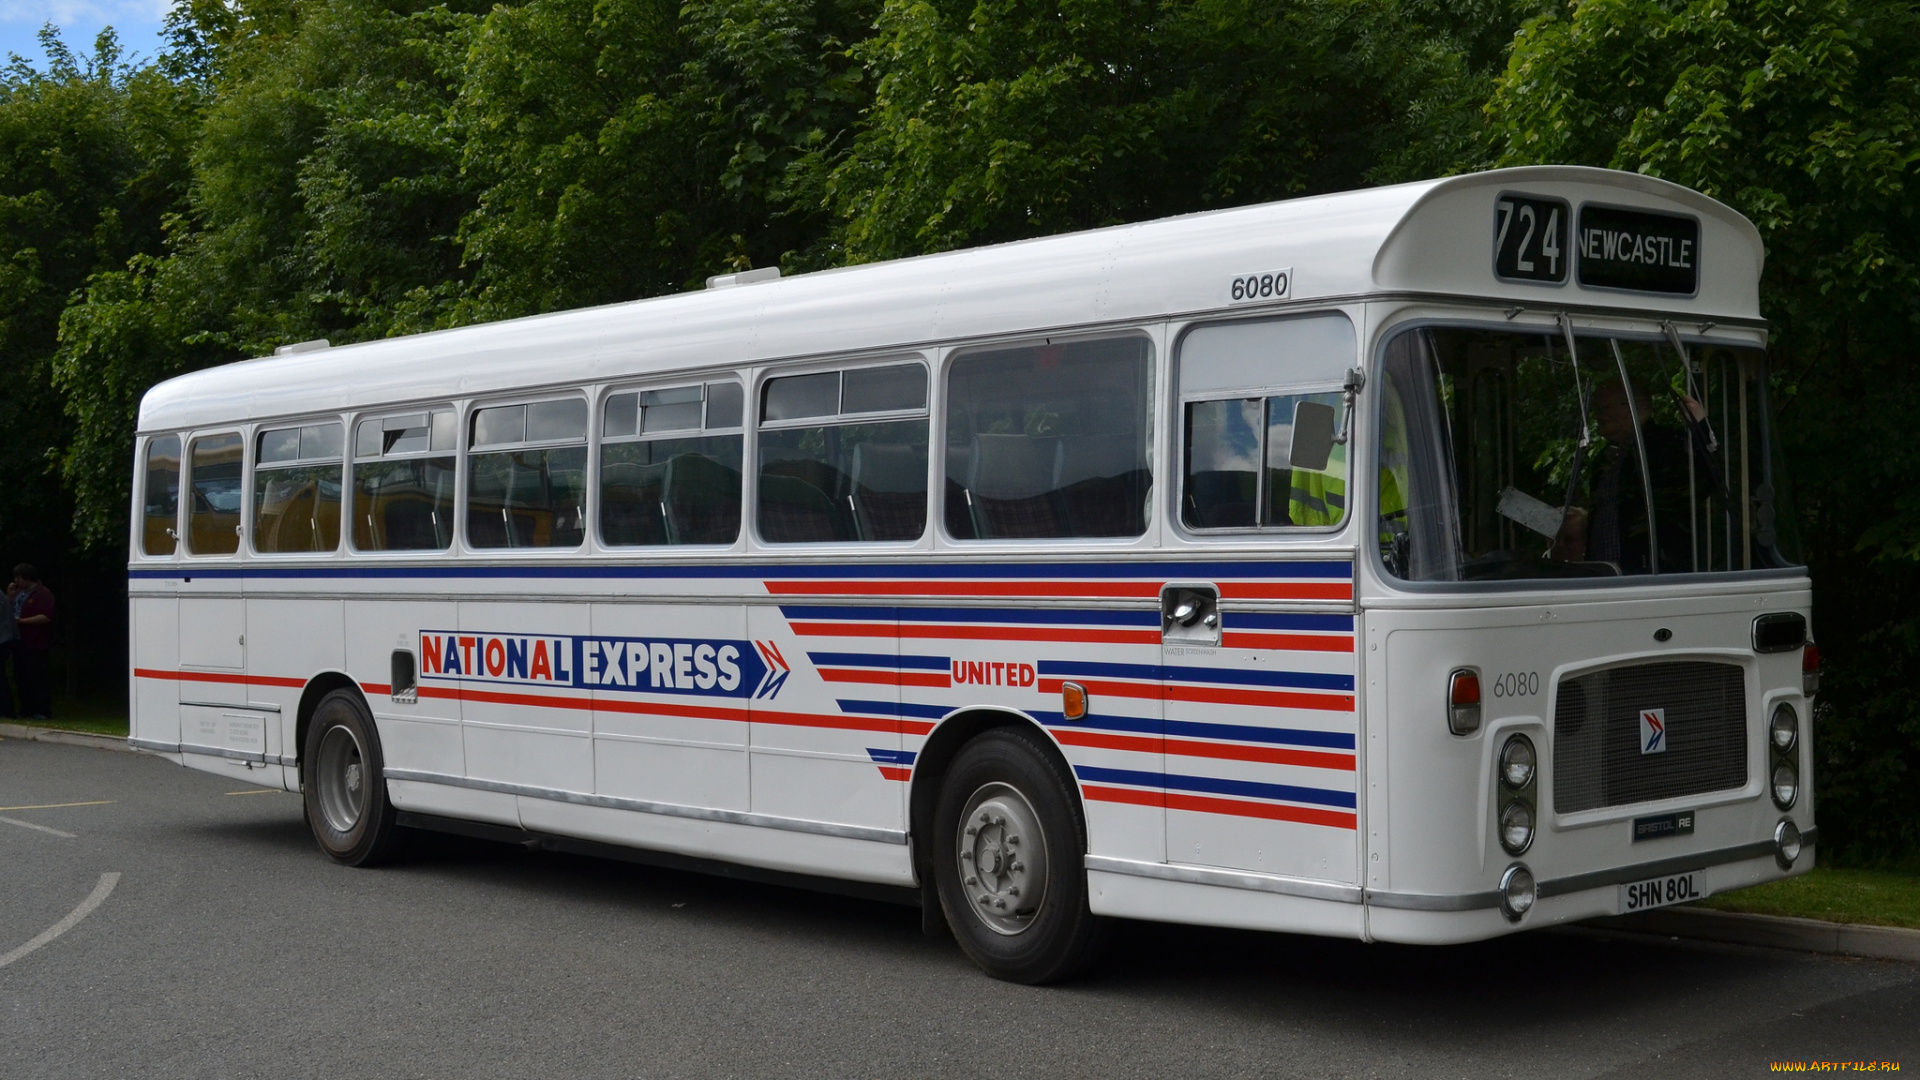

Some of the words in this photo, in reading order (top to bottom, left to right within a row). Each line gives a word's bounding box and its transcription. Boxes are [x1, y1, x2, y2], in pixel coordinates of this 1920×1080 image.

[1496, 201, 1560, 275] 724
[1579, 228, 1692, 269] NEWCASTLE
[1231, 272, 1288, 300] 6080
[422, 635, 570, 682] NATIONAL
[583, 640, 741, 691] EXPRESS
[1164, 648, 1185, 656] WATER
[952, 660, 1035, 688] UNITED
[1494, 671, 1539, 698] 6080
[1637, 821, 1675, 835] BRISTOL
[1678, 817, 1691, 829] RE
[1627, 880, 1662, 909] SHN
[1665, 874, 1699, 901] 80L
